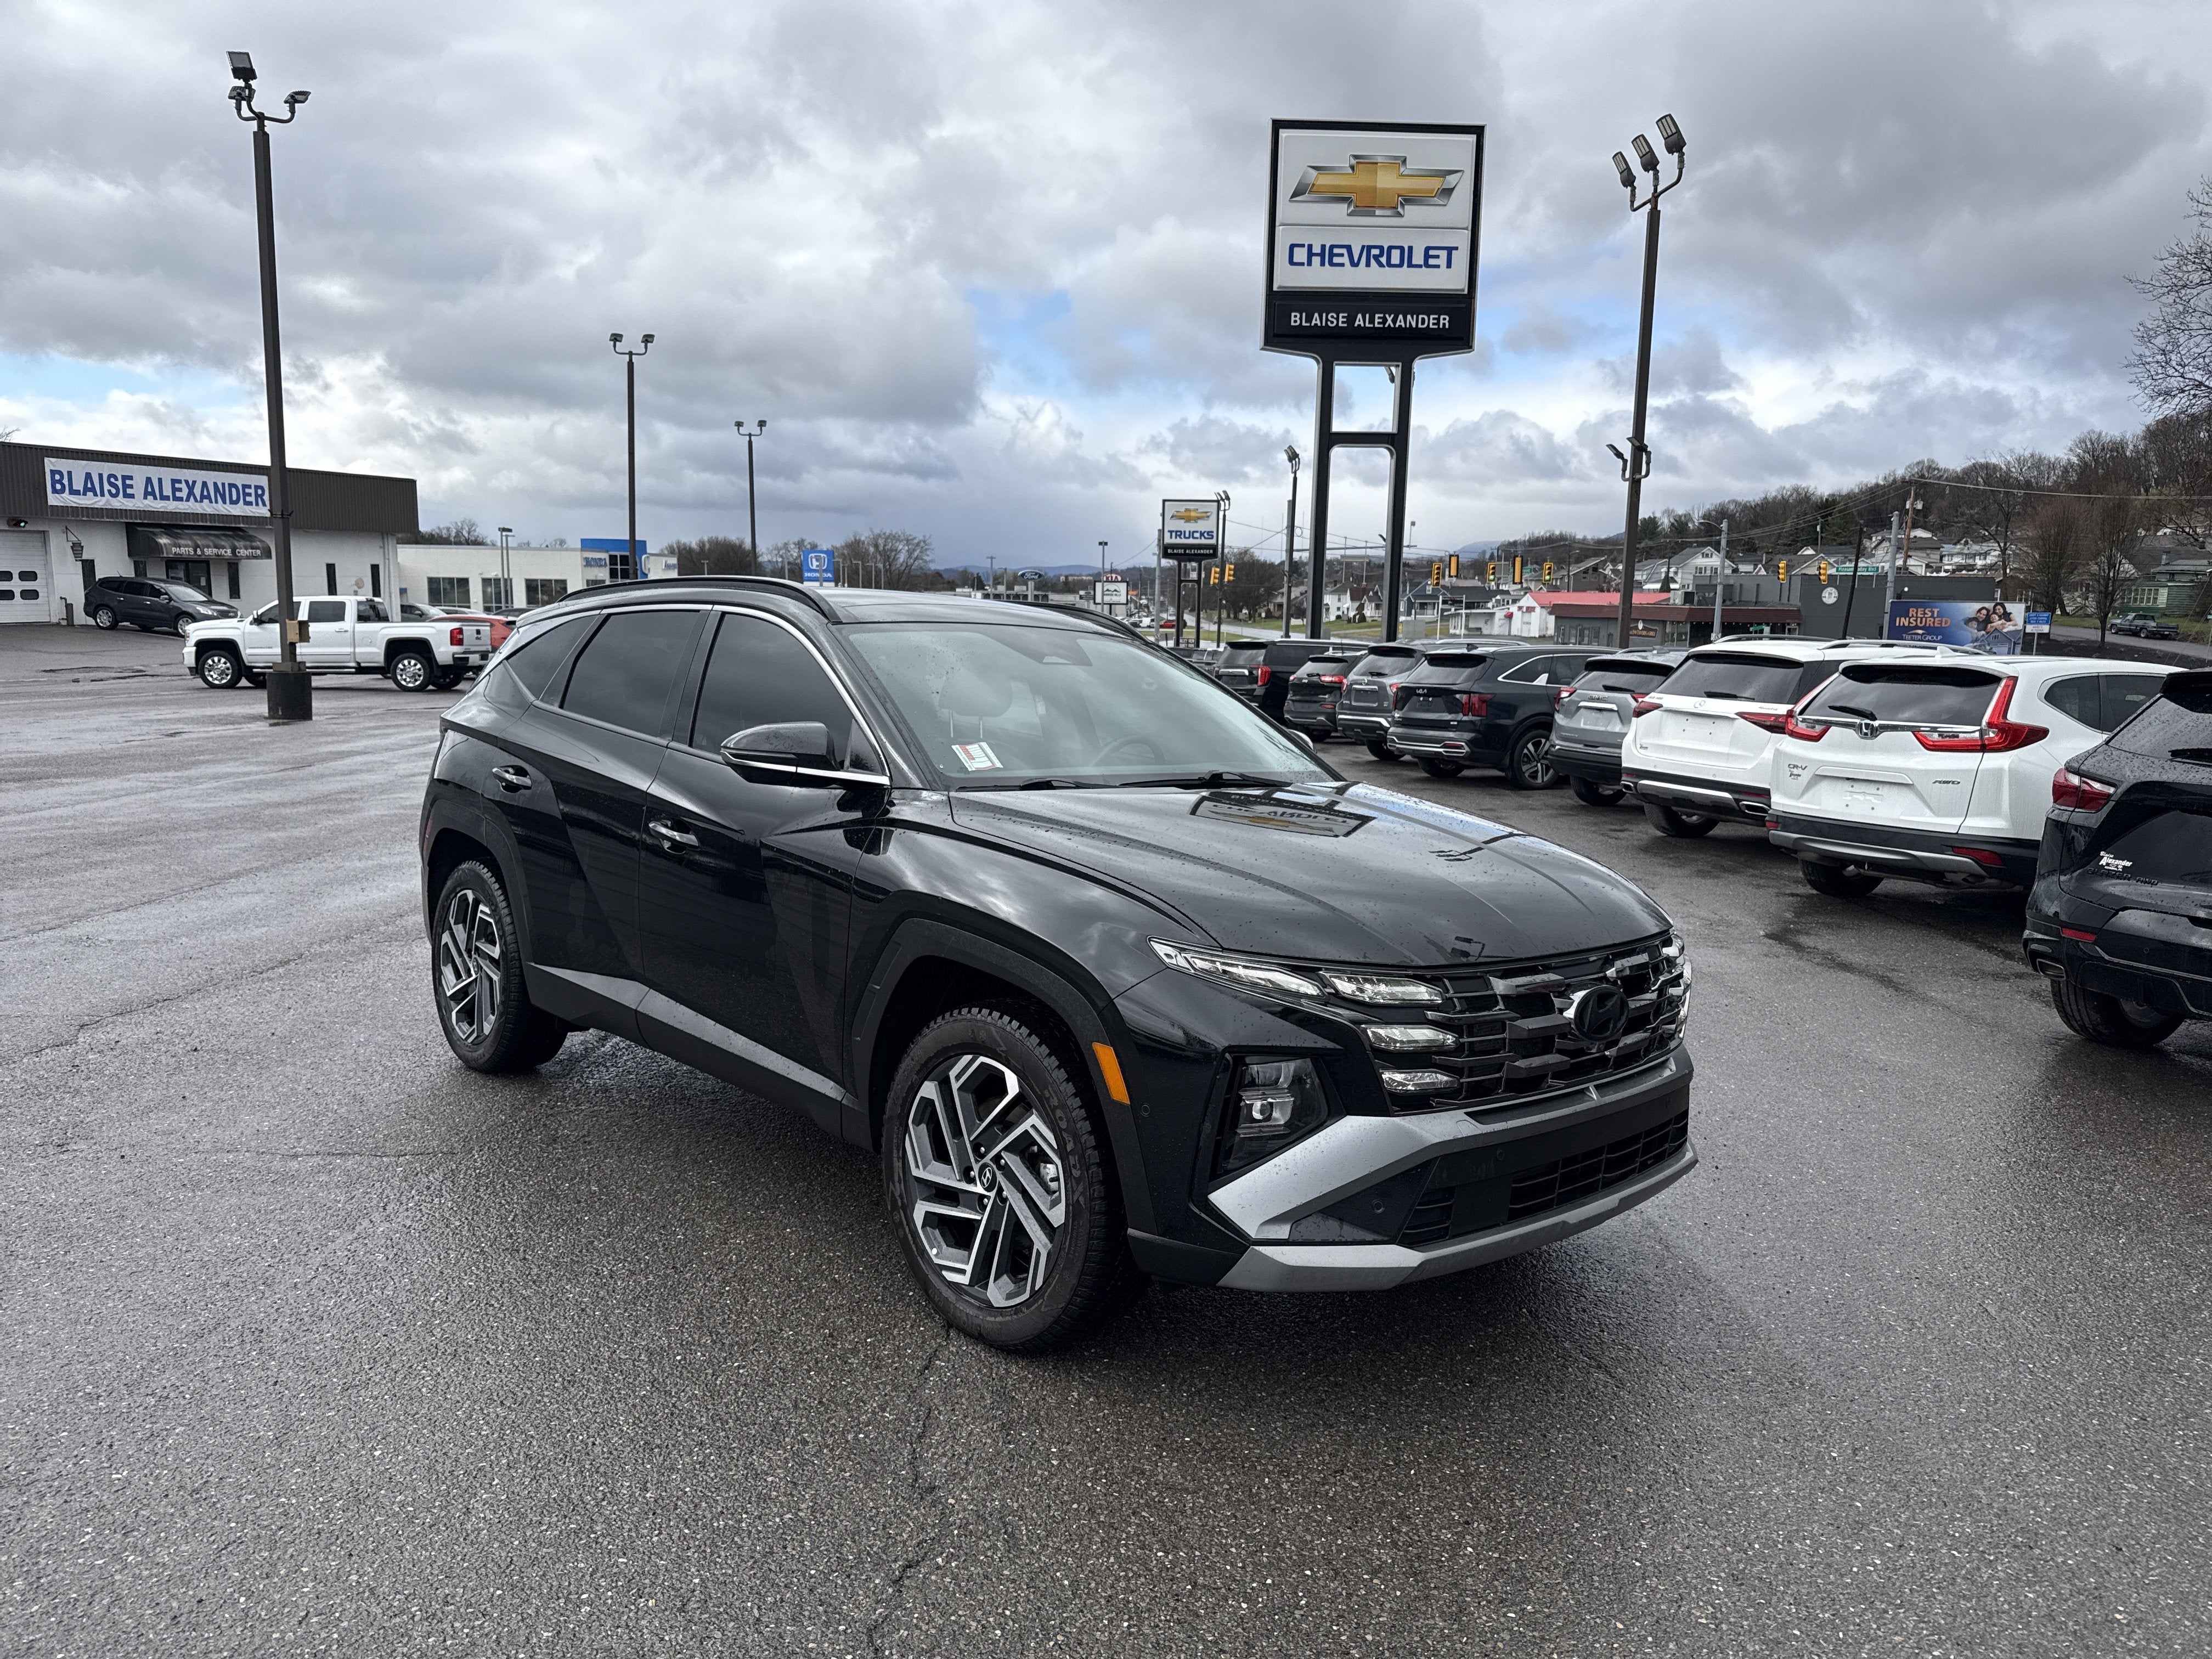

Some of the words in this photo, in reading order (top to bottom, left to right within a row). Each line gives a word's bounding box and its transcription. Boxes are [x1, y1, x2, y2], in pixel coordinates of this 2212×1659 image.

[1288, 243, 1459, 269] CHEVROLET
[1290, 312, 1347, 327] BLAISE
[1354, 313, 1449, 329] ALEXANDER
[49, 469, 136, 499] BLAISE
[143, 476, 267, 507] ALEXANDER
[1167, 530, 1214, 540] TRUCKS
[172, 547, 194, 556] PARTS
[204, 548, 232, 556] SERVICE
[1909, 608, 1940, 618] REST
[1895, 617, 1951, 627] INSURED
[2098, 856, 2133, 867] Alexander
[2087, 867, 2132, 881] BLAZER
[2136, 877, 2159, 885] AWD
